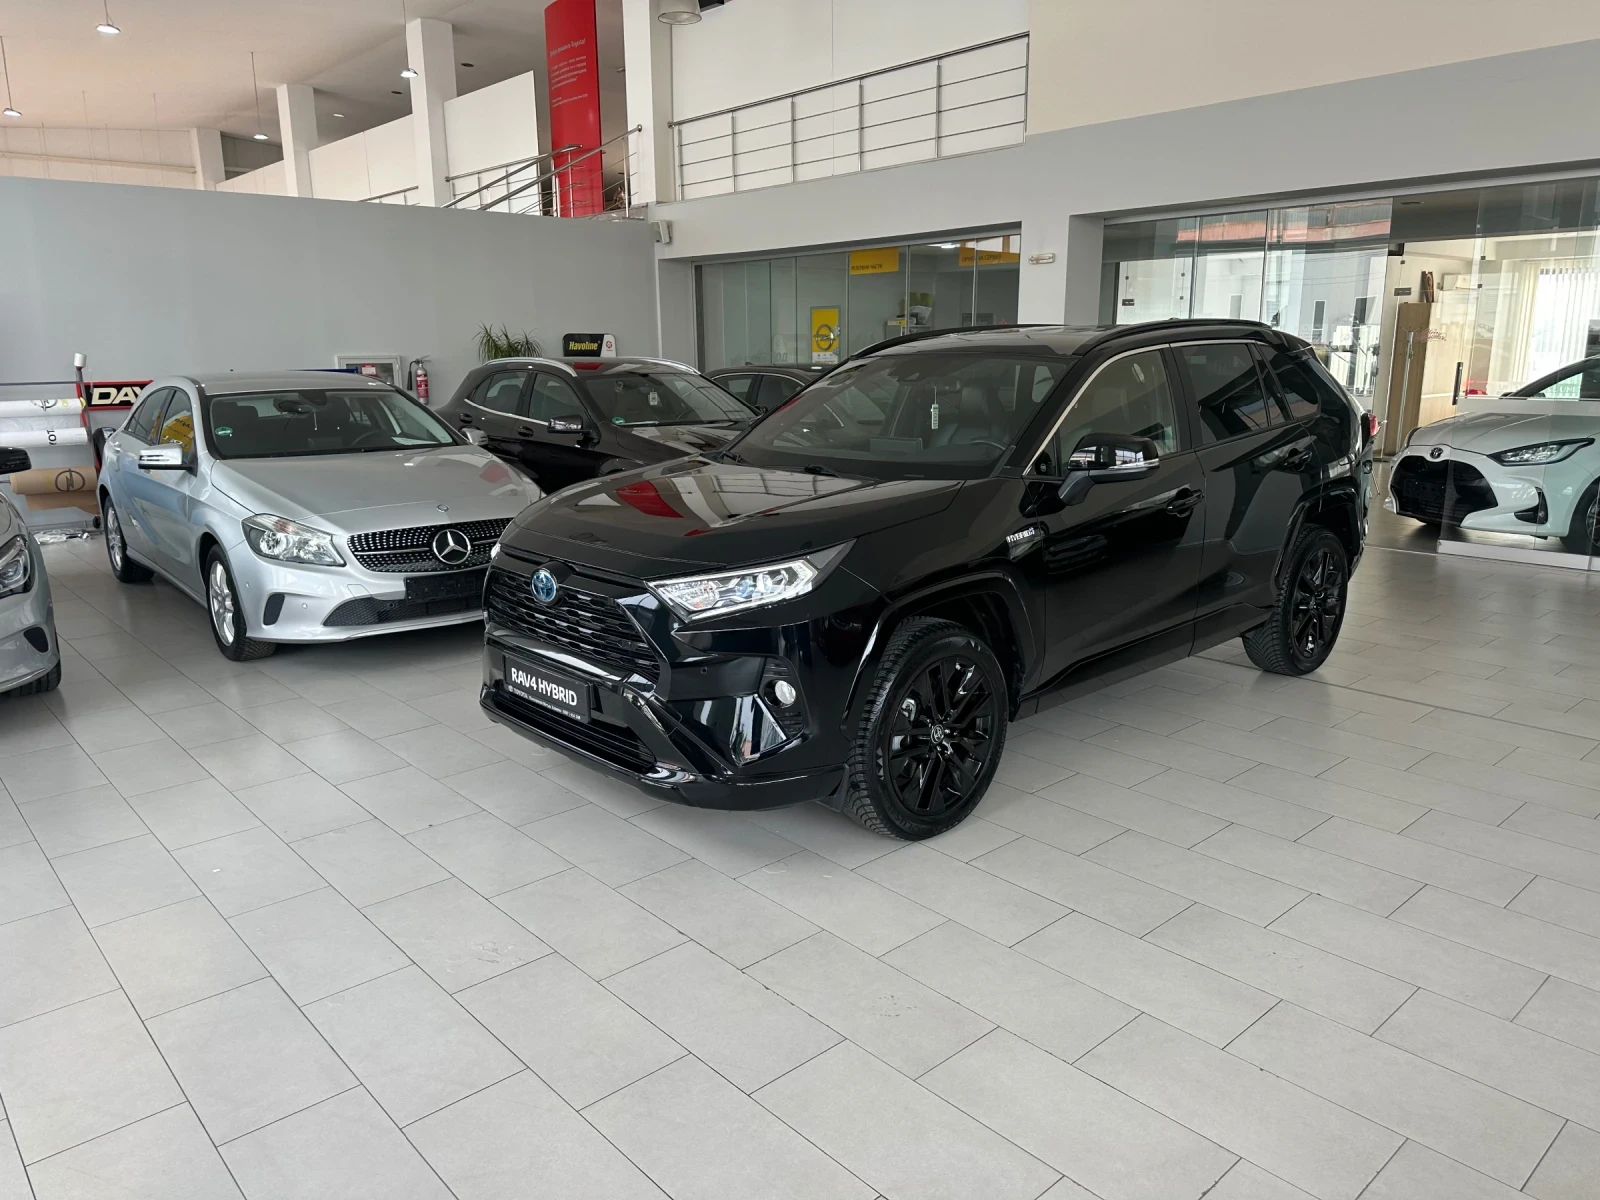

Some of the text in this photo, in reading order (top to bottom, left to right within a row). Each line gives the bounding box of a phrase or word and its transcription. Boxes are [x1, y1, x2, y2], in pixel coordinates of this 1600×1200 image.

[569, 341, 598, 350] Havoline
[511, 667, 577, 706] RAV4 HYBRID
